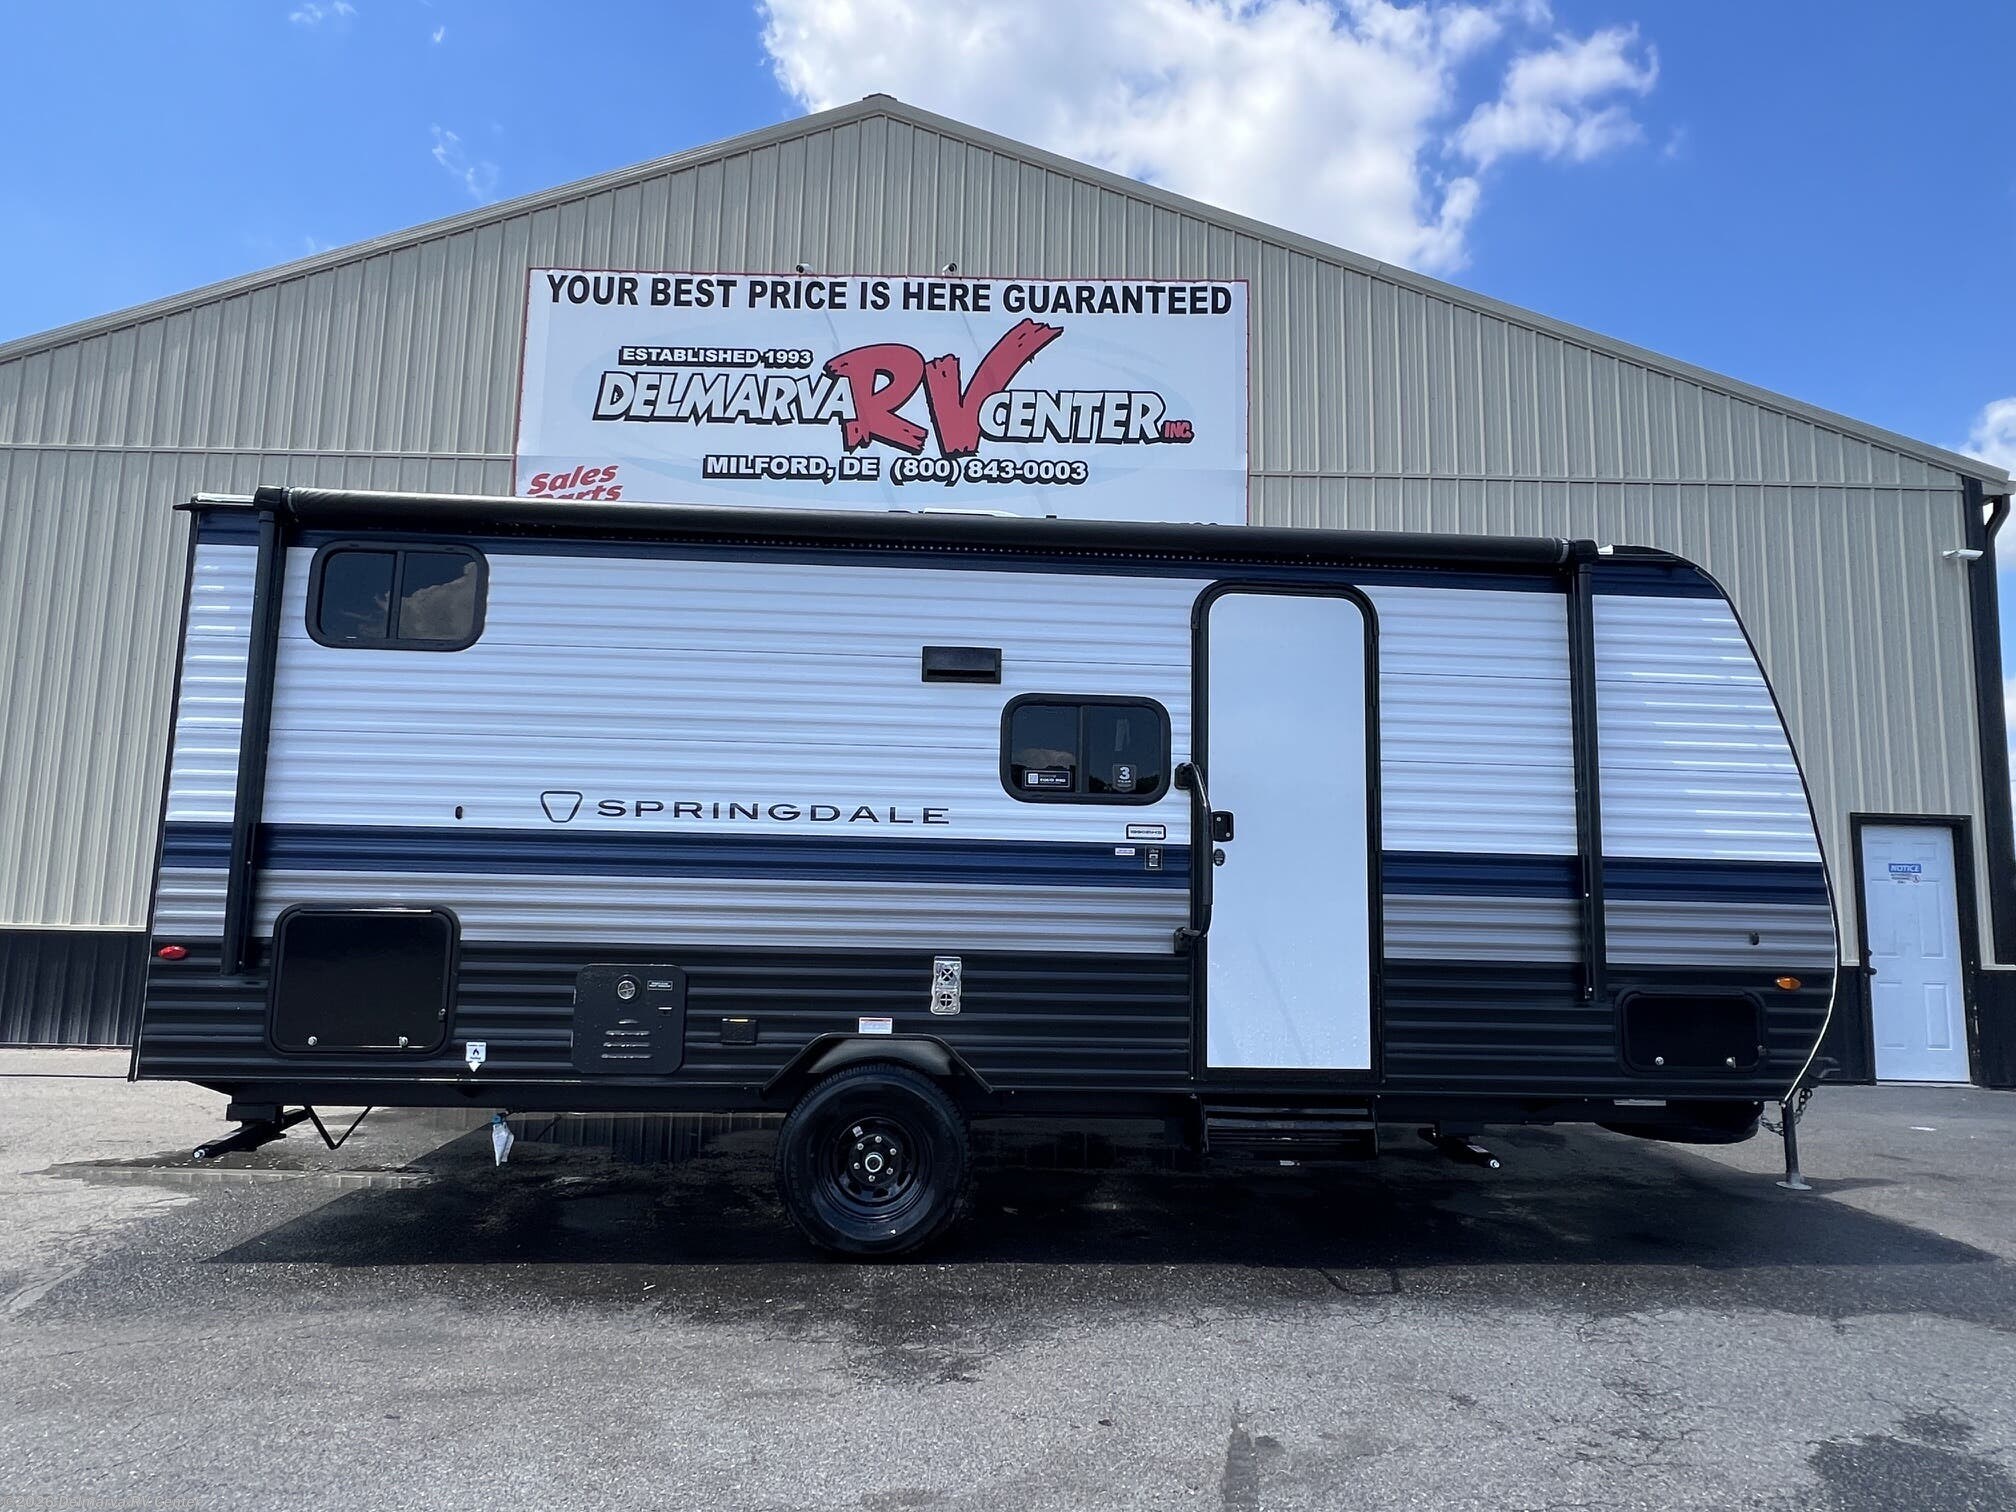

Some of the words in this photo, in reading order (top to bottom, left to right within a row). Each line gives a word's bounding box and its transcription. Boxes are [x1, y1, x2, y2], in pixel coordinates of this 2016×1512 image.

[547, 274, 639, 306] YOUR
[650, 277, 737, 308] BEST
[749, 280, 848, 309] PRICE
[860, 281, 891, 310] IS
[902, 281, 992, 312] HERE
[1003, 284, 1233, 315] GUARANTEED
[620, 346, 760, 366] ESTABLISHED
[765, 349, 813, 366] 1993
[593, 371, 858, 426] DELMARVA
[823, 318, 1064, 457] RV
[977, 389, 1166, 444] CENTER
[527, 465, 619, 495] Sales
[703, 455, 837, 484] MILFORD,
[839, 457, 880, 480] DE
[892, 458, 961, 486] (800)
[964, 459, 1089, 485] 843-0003
[1119, 766, 1130, 780] 3
[597, 799, 950, 825] SPRINGDALE
[1890, 864, 1920, 872] NOTICE
